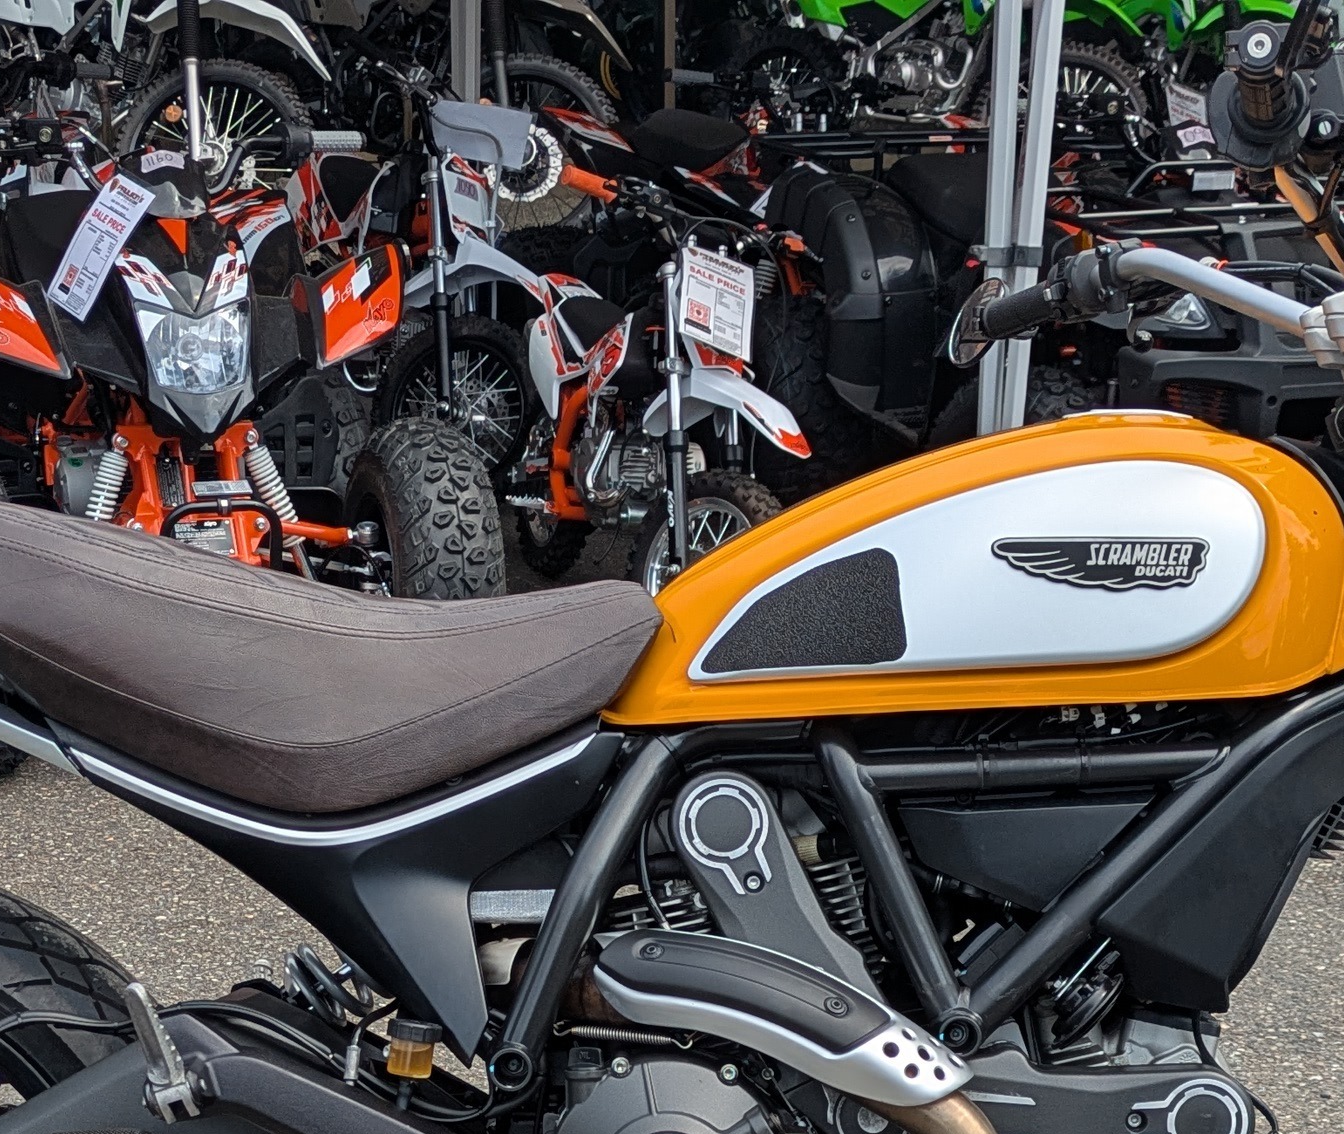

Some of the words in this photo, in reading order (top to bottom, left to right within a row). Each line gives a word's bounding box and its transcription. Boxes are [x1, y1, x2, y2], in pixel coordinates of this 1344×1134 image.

[91, 207, 108, 224] SALE
[106, 214, 127, 235] PRICE
[689, 265, 715, 282] SALE
[716, 277, 747, 297] PRICE
[667, 489, 676, 528] KAYO
[1086, 543, 1194, 566] SCRAMBLER
[1134, 565, 1188, 577] DUCATI
